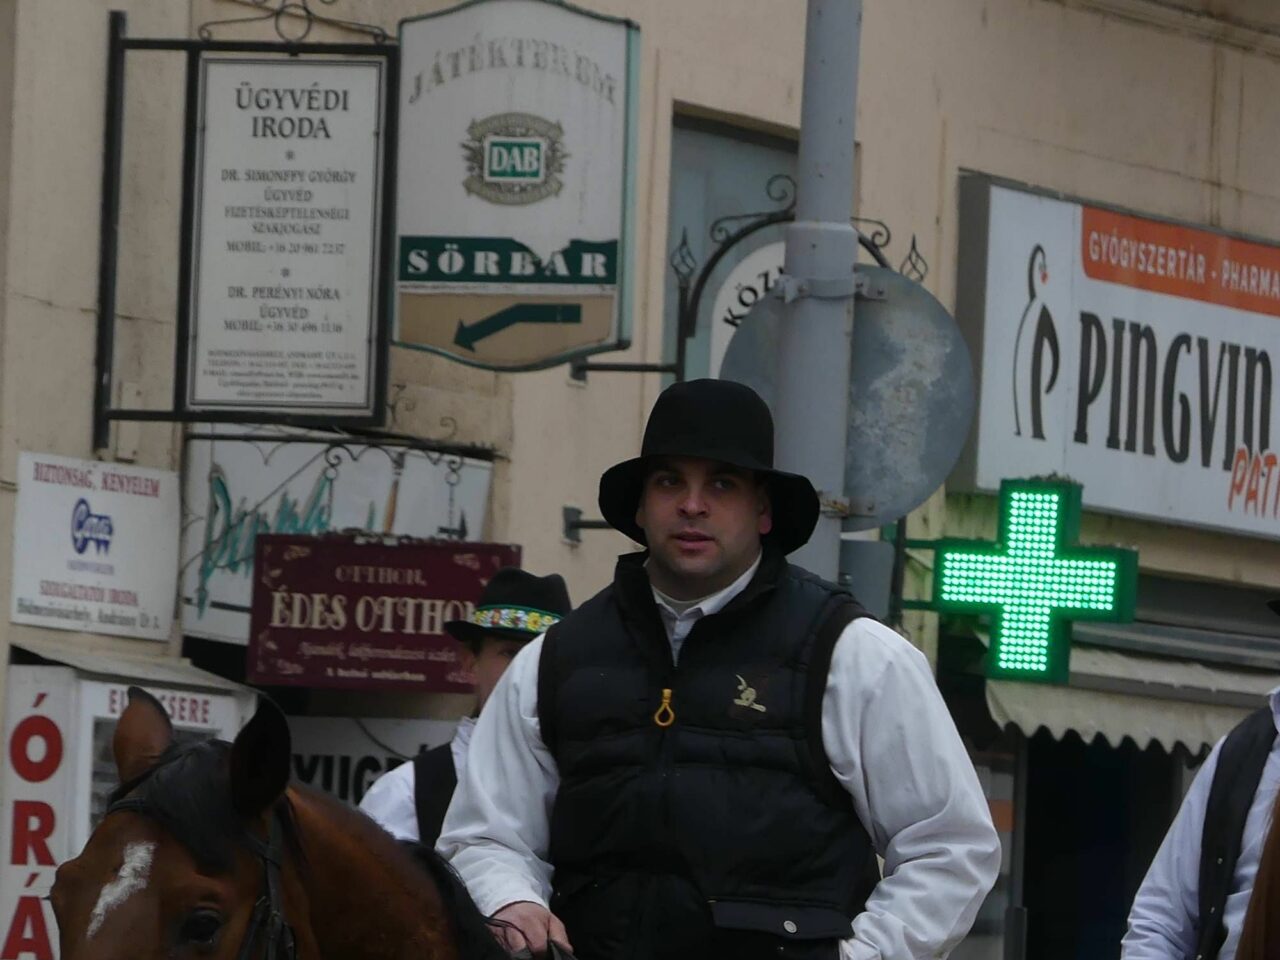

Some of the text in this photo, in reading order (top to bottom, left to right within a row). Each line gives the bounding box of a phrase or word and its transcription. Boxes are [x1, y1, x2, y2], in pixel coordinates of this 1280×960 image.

[235, 82, 350, 111] ÜGYVÉDI
[251, 116, 331, 138] IRODA
[490, 146, 540, 172] DAB
[221, 169, 240, 182] DR.
[1088, 228, 1206, 285] GYÓGYSZERTÁR
[228, 285, 247, 299] DR.
[722, 264, 787, 328] KÖZ
[1073, 311, 1273, 472] PINGVIN
[269, 585, 348, 631] ÉDES
